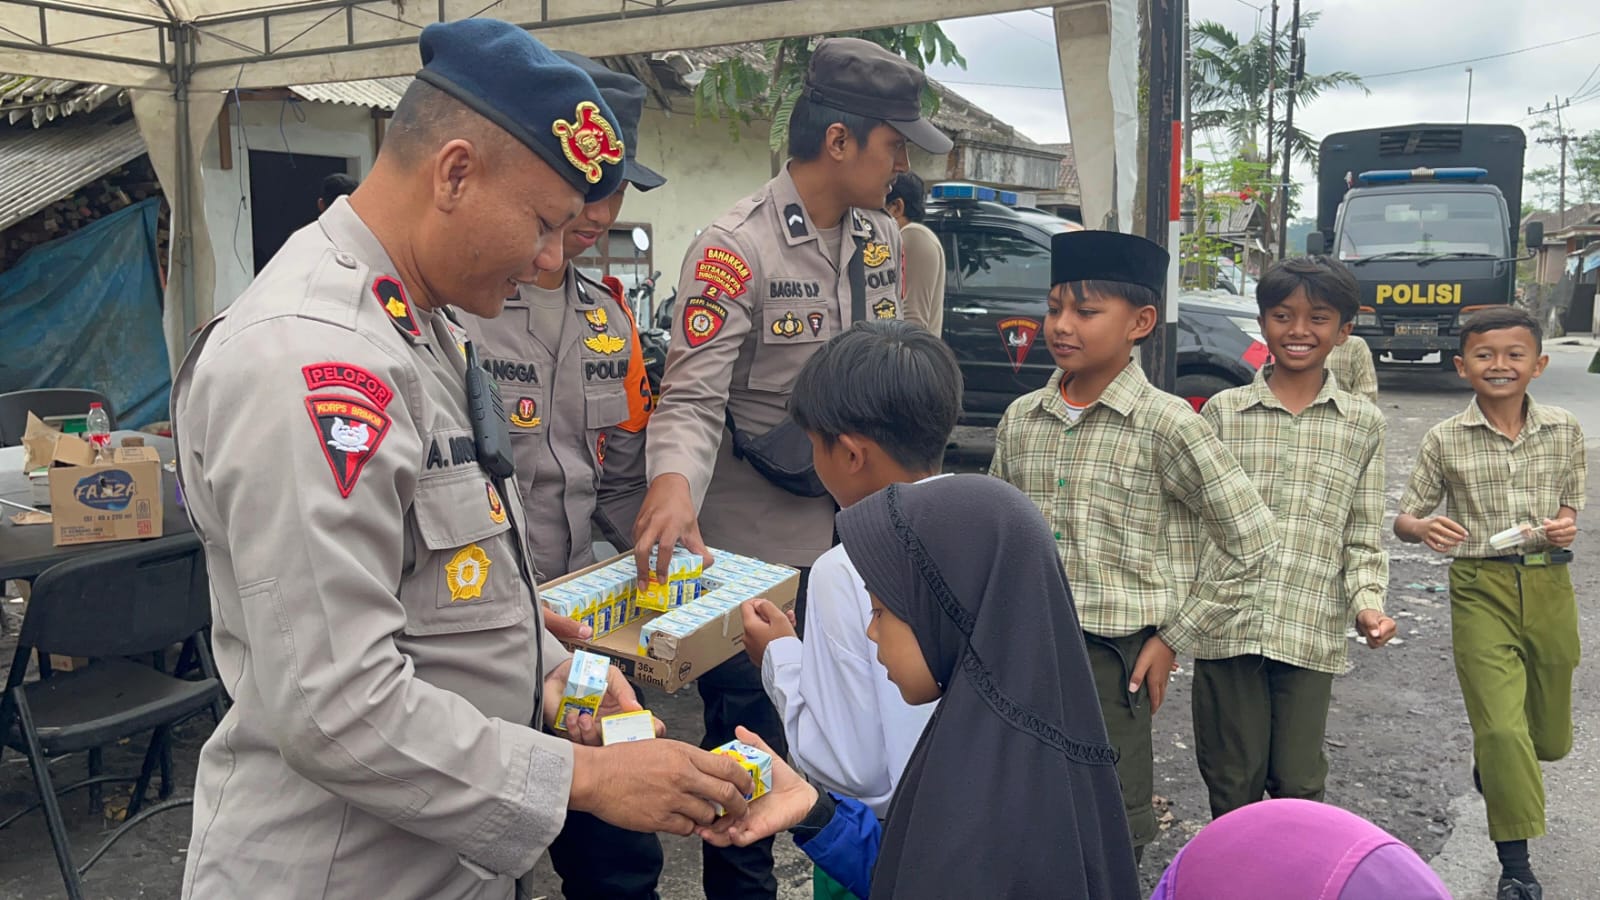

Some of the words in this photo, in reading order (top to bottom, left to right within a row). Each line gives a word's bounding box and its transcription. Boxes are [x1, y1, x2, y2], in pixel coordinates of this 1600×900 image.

[708, 249, 750, 278] BAHARKAM
[699, 263, 742, 291] DITSAMAPTA
[706, 286, 718, 297] 2
[770, 281, 803, 298] BAGAS
[1376, 284, 1462, 304] POLISI
[311, 366, 388, 403] PELOPOR
[316, 402, 347, 415] KORPS
[637, 662, 654, 675] 36x
